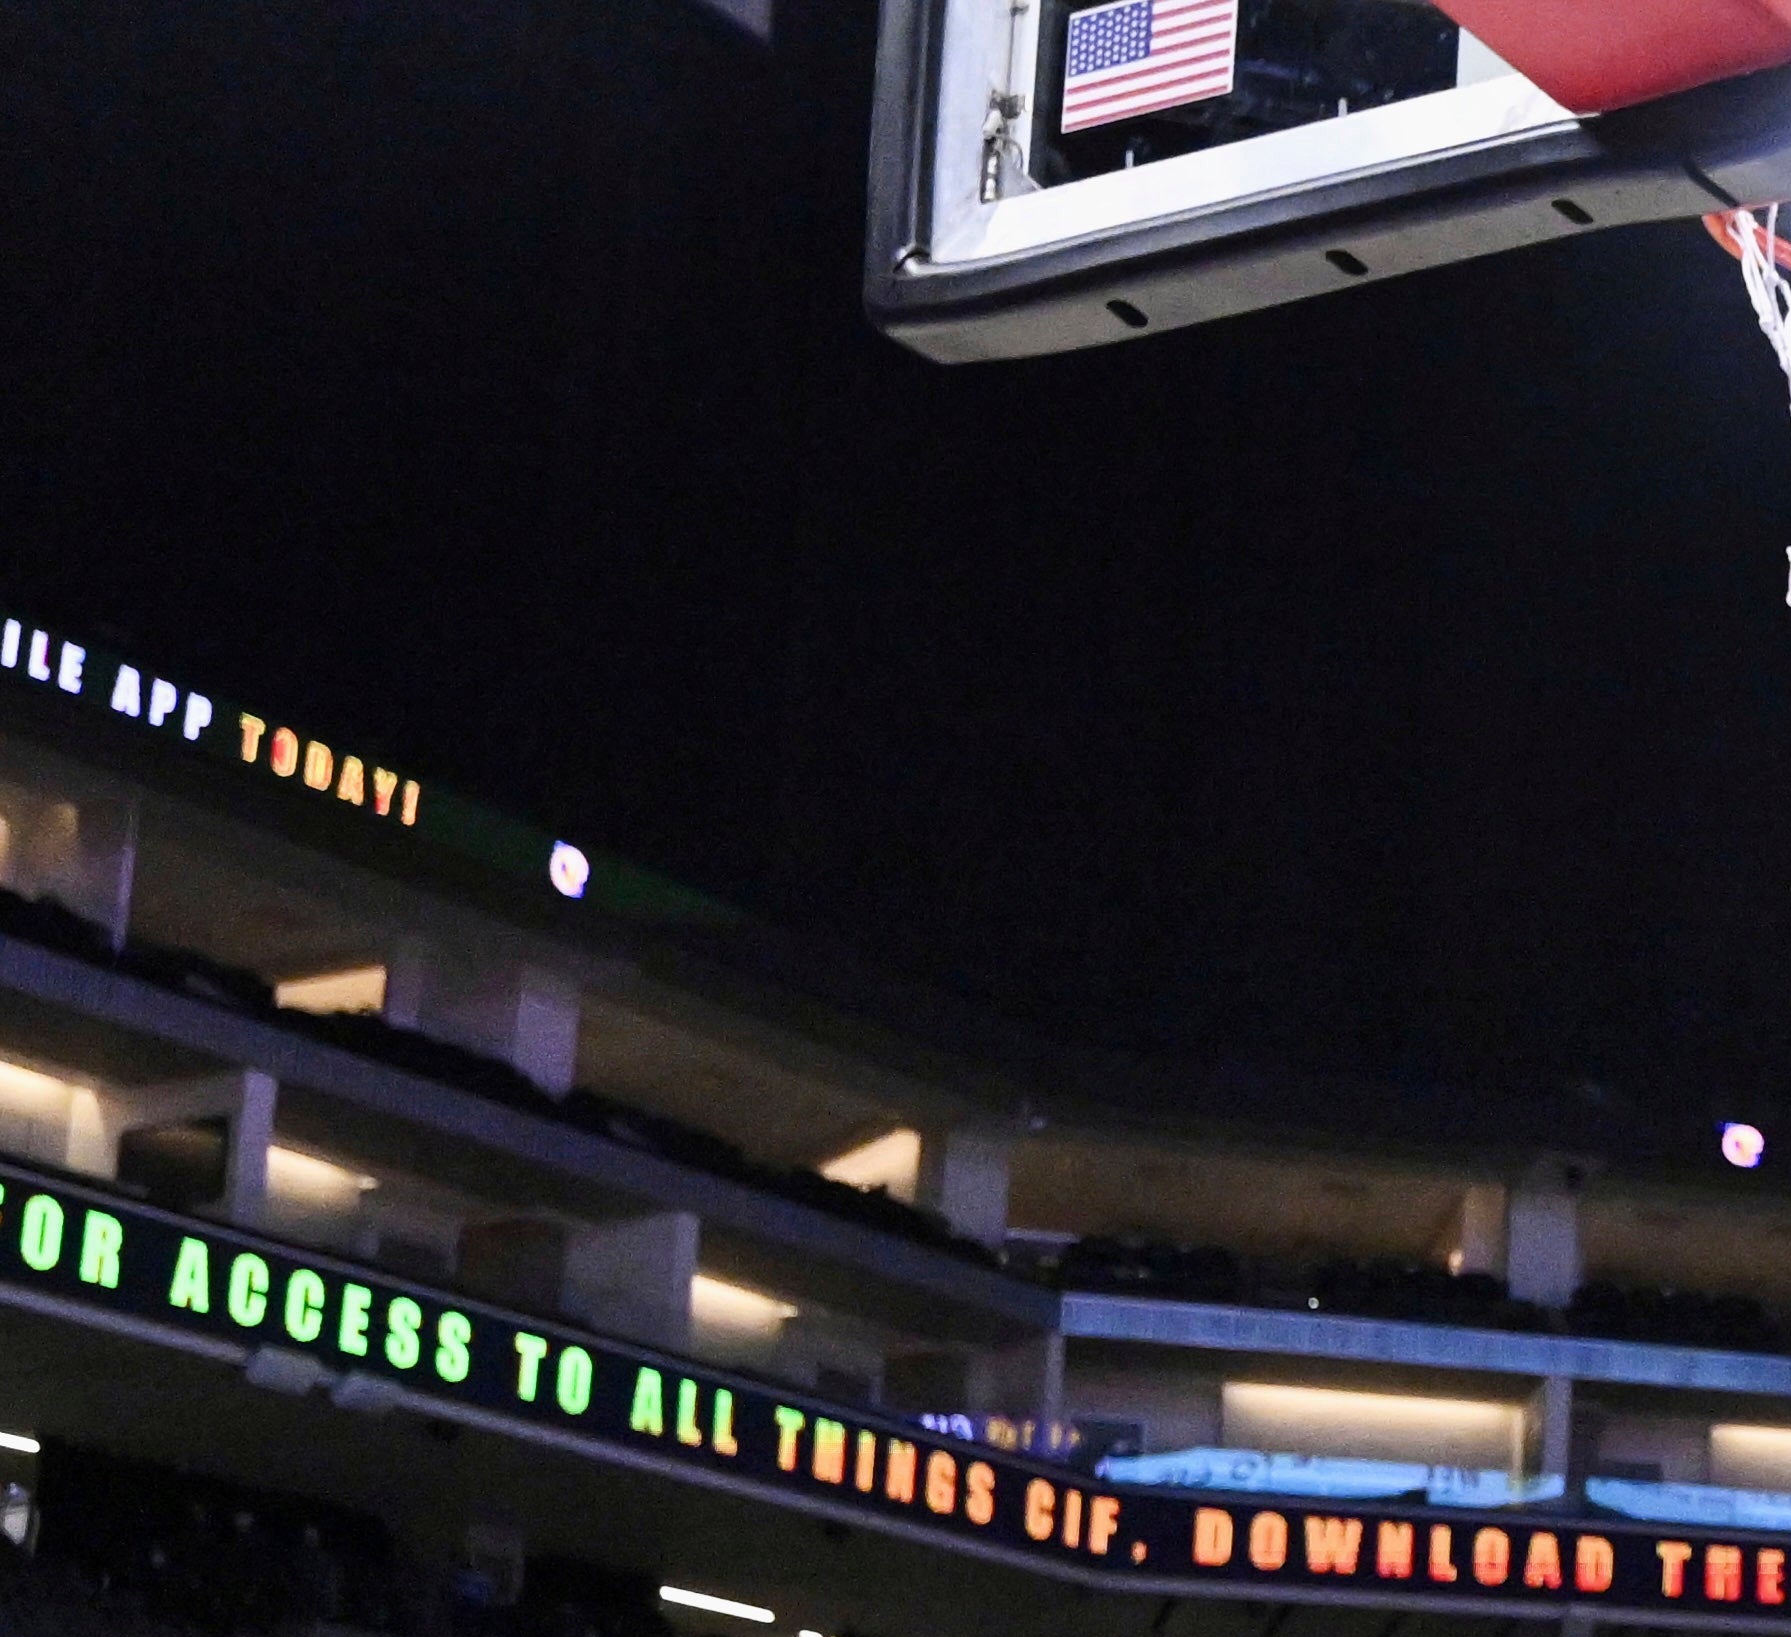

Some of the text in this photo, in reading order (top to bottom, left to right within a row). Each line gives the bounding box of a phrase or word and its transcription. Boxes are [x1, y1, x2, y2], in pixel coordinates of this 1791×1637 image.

[1, 618, 420, 825] ILE APP TODAY!
[0, 1184, 123, 1289] OR
[169, 1236, 472, 1385] ACCESS
[514, 1331, 593, 1415] TO
[631, 1366, 738, 1456] ALL
[775, 1405, 996, 1525] THINGS
[1193, 1508, 1614, 1592] DOWNLOAD
[1656, 1541, 1785, 1604] THE
